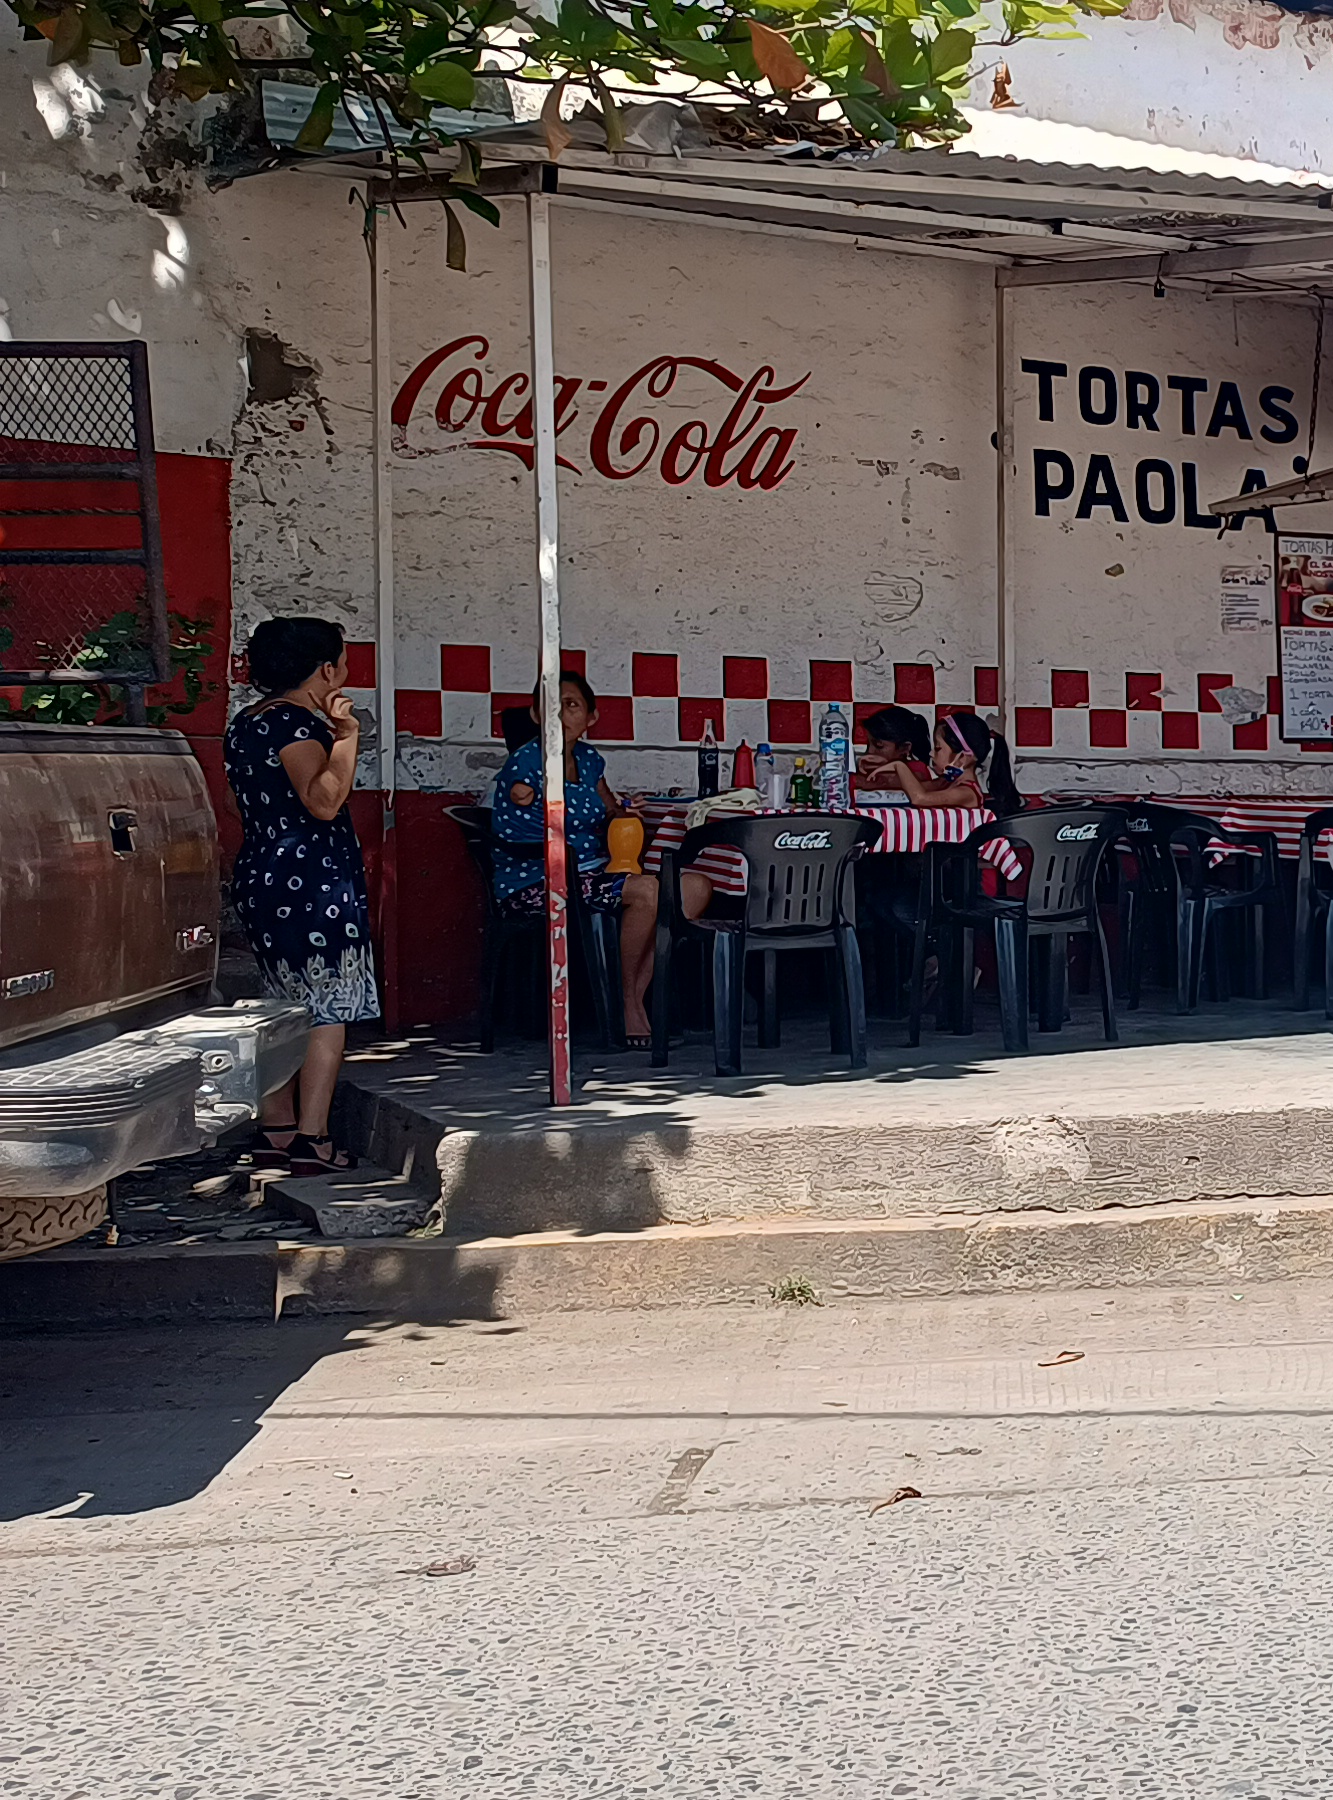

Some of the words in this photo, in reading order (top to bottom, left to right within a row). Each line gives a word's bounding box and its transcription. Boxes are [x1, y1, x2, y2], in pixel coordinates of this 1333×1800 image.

[390, 334, 812, 492] Coca-Cola
[1020, 356, 1299, 444] TORTAS
[1033, 448, 1277, 533] PAOLA
[774, 831, 832, 850] Coca-Cola
[1056, 823, 1101, 841] Coca-Cola
